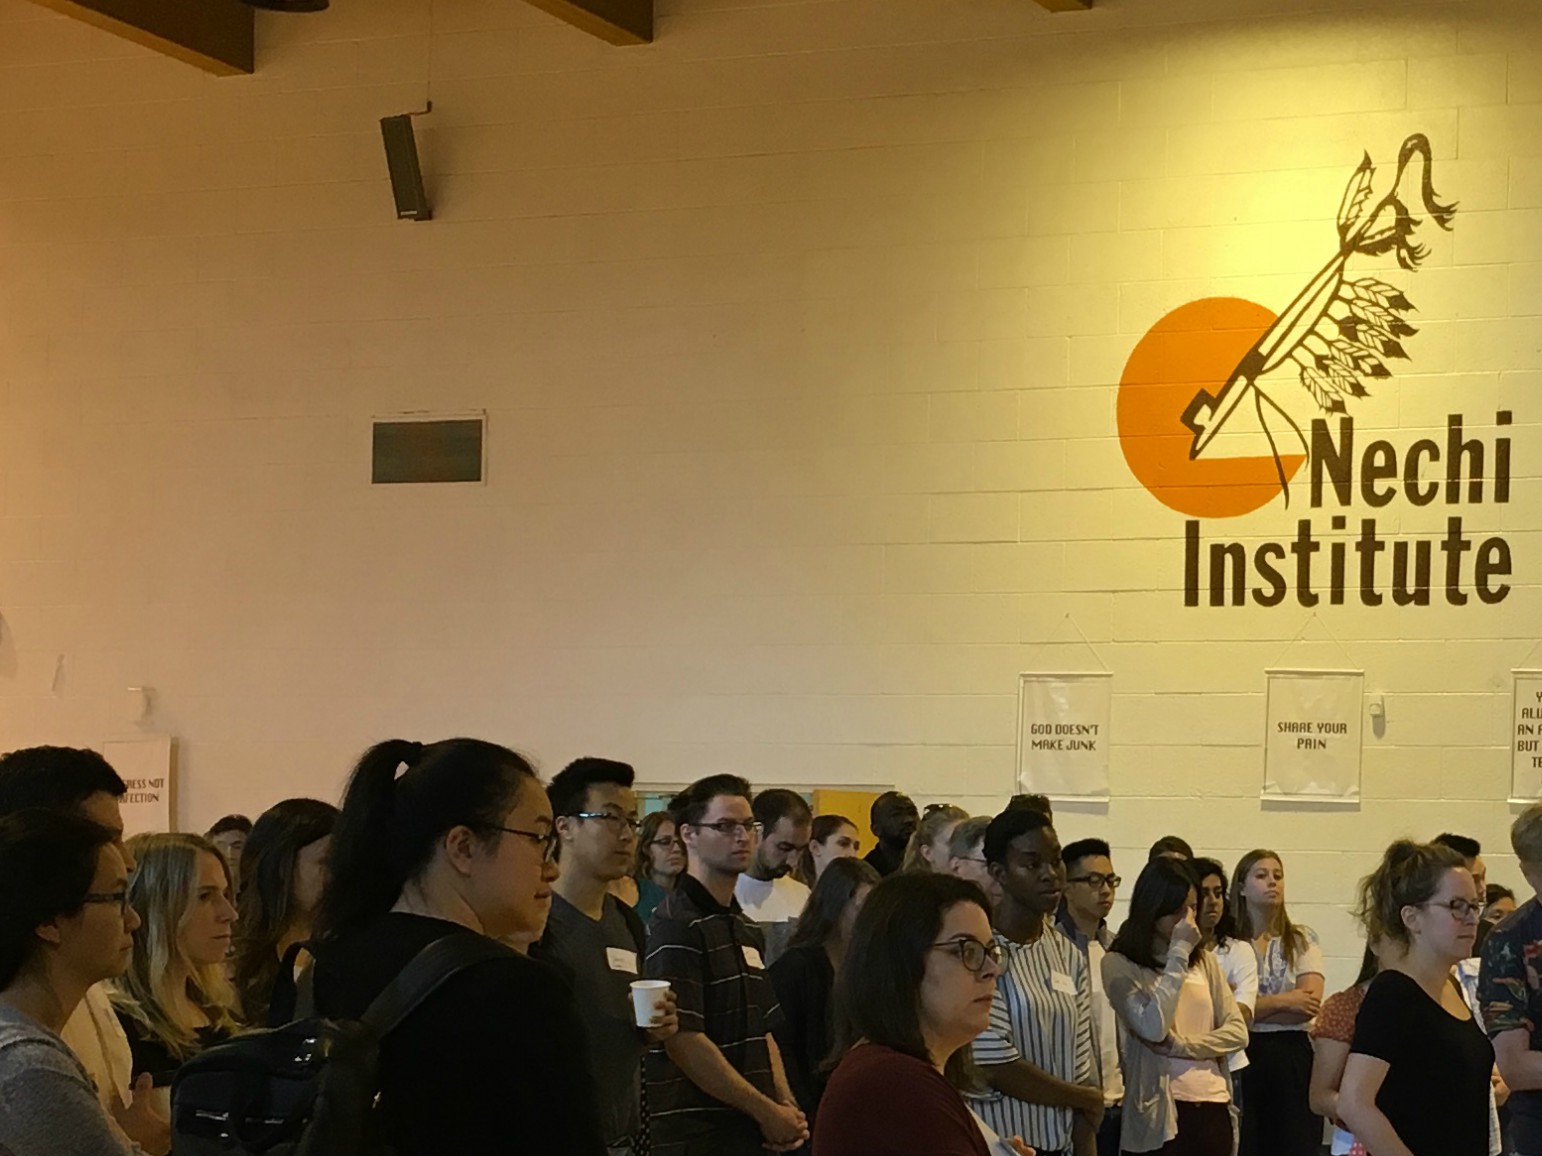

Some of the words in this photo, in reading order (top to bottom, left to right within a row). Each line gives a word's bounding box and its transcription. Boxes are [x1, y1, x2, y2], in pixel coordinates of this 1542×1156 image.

[1310, 410, 1513, 508] Nechi
[1184, 515, 1513, 608] Institute
[1031, 723, 1052, 735] GOD
[1055, 724, 1099, 735] DOESN'T
[1277, 721, 1313, 733] SHARE
[1316, 722, 1348, 734] YOUR
[1517, 724, 1534, 736] AN
[1031, 739, 1063, 751] MAKE
[1066, 740, 1097, 751] JUNK
[1297, 737, 1327, 750] PAIN
[1517, 740, 1539, 752] BUT
[148, 778, 164, 789] NOT
